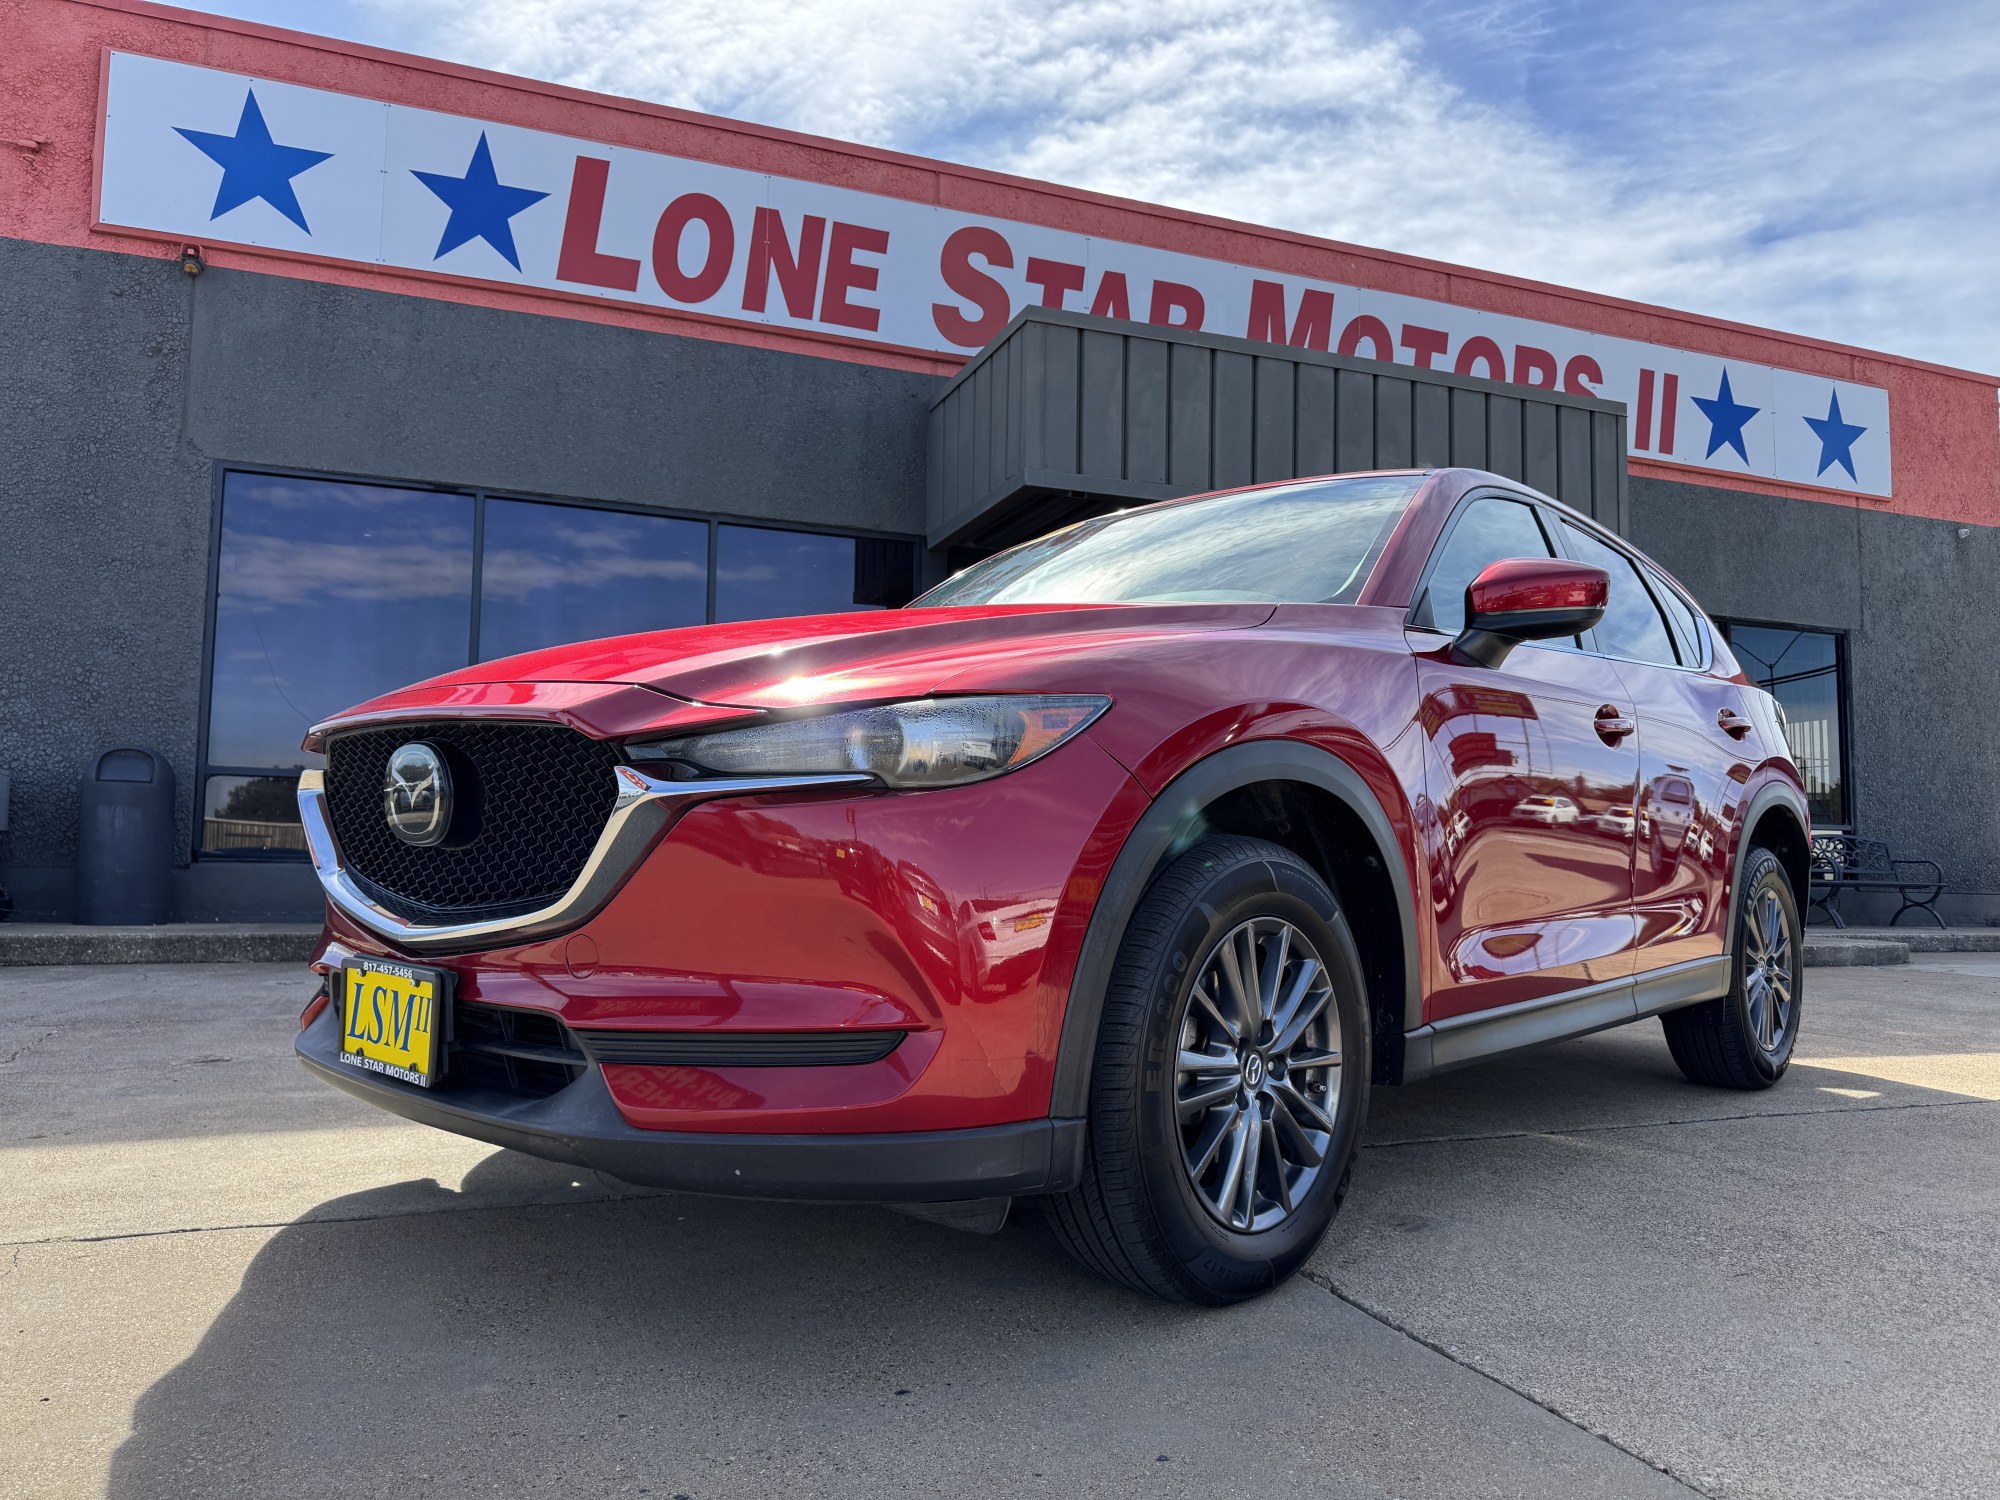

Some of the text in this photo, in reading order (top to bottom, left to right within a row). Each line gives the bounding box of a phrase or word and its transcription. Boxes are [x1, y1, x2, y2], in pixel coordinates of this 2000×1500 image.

[556, 155, 890, 332] LONE
[1634, 368, 1679, 456] II
[363, 961, 413, 979] 817-457-5456
[347, 982, 417, 1052] LSM
[340, 1052, 362, 1067] LONE
[364, 1058, 384, 1074] STAR
[385, 1064, 420, 1085] MOTORS
